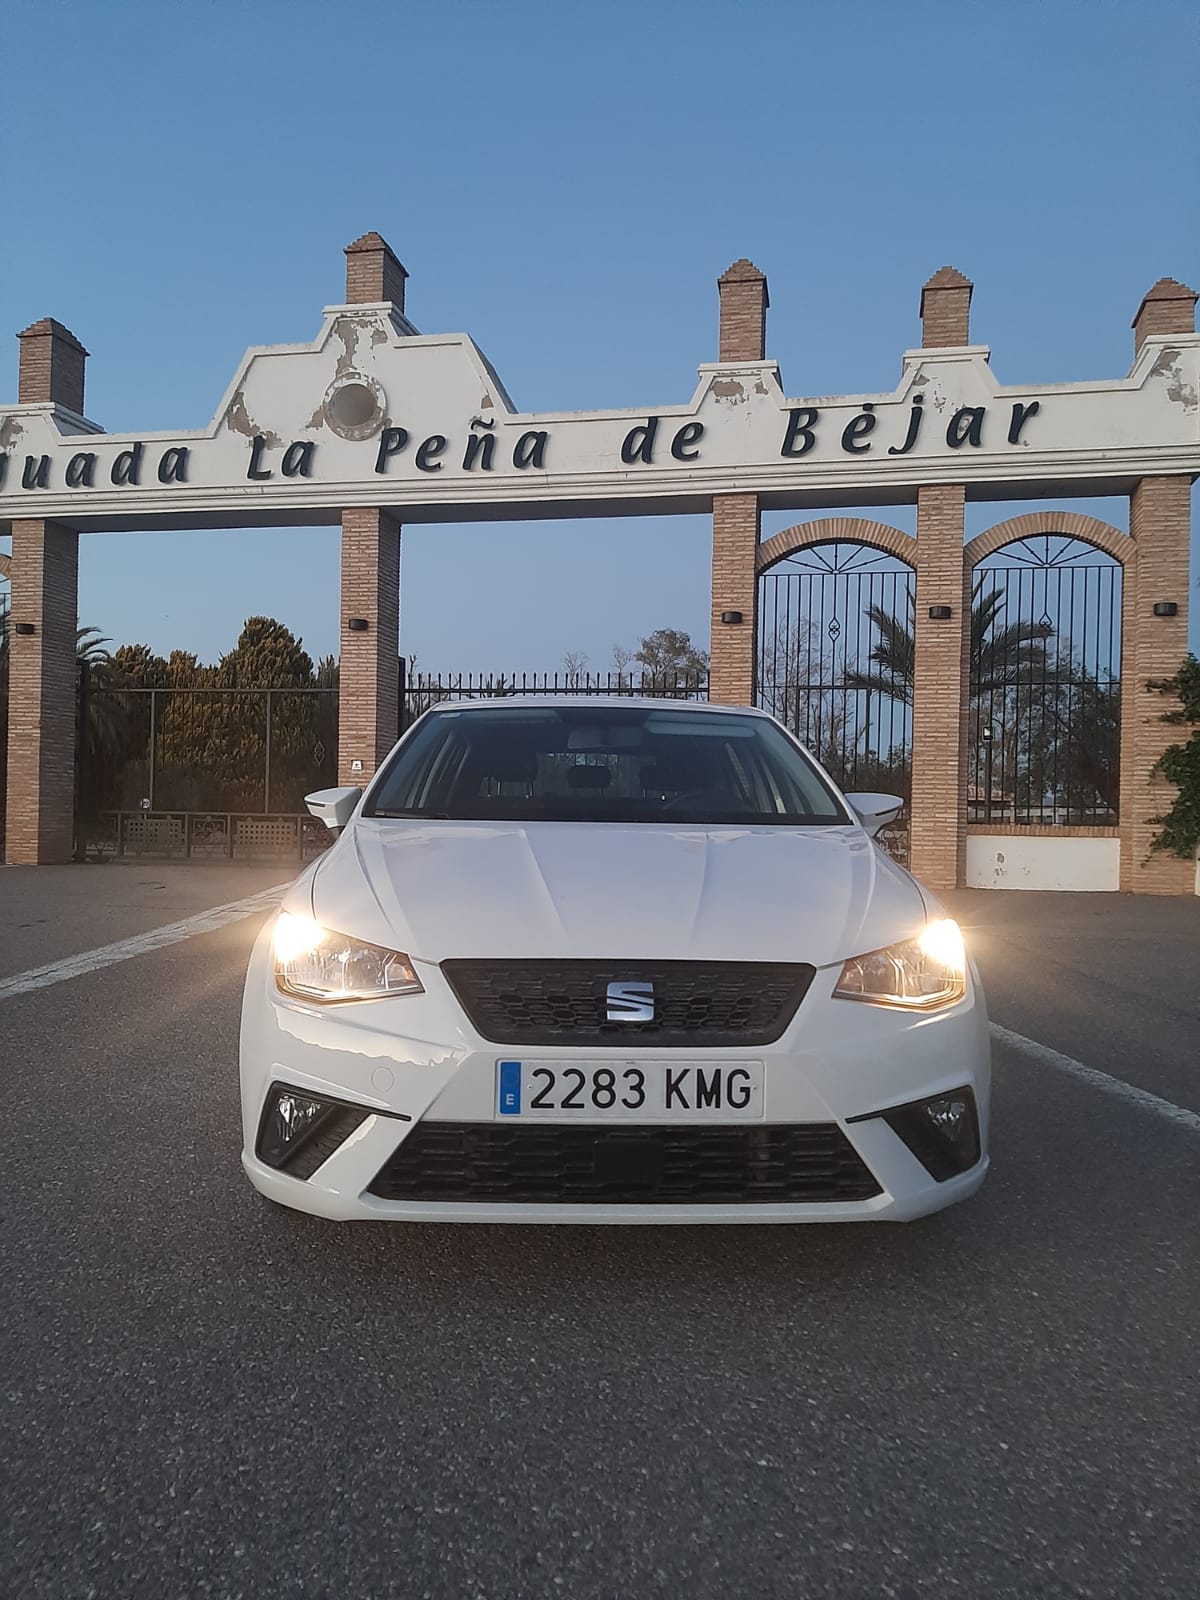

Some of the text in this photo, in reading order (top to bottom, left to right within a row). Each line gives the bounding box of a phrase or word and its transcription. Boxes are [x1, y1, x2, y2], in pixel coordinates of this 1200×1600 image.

[0, 441, 189, 491] uada
[247, 434, 315, 480] La
[374, 417, 548, 474] Peña
[621, 416, 704, 465] de
[505, 1068, 751, 1109] E 2283 KMG
